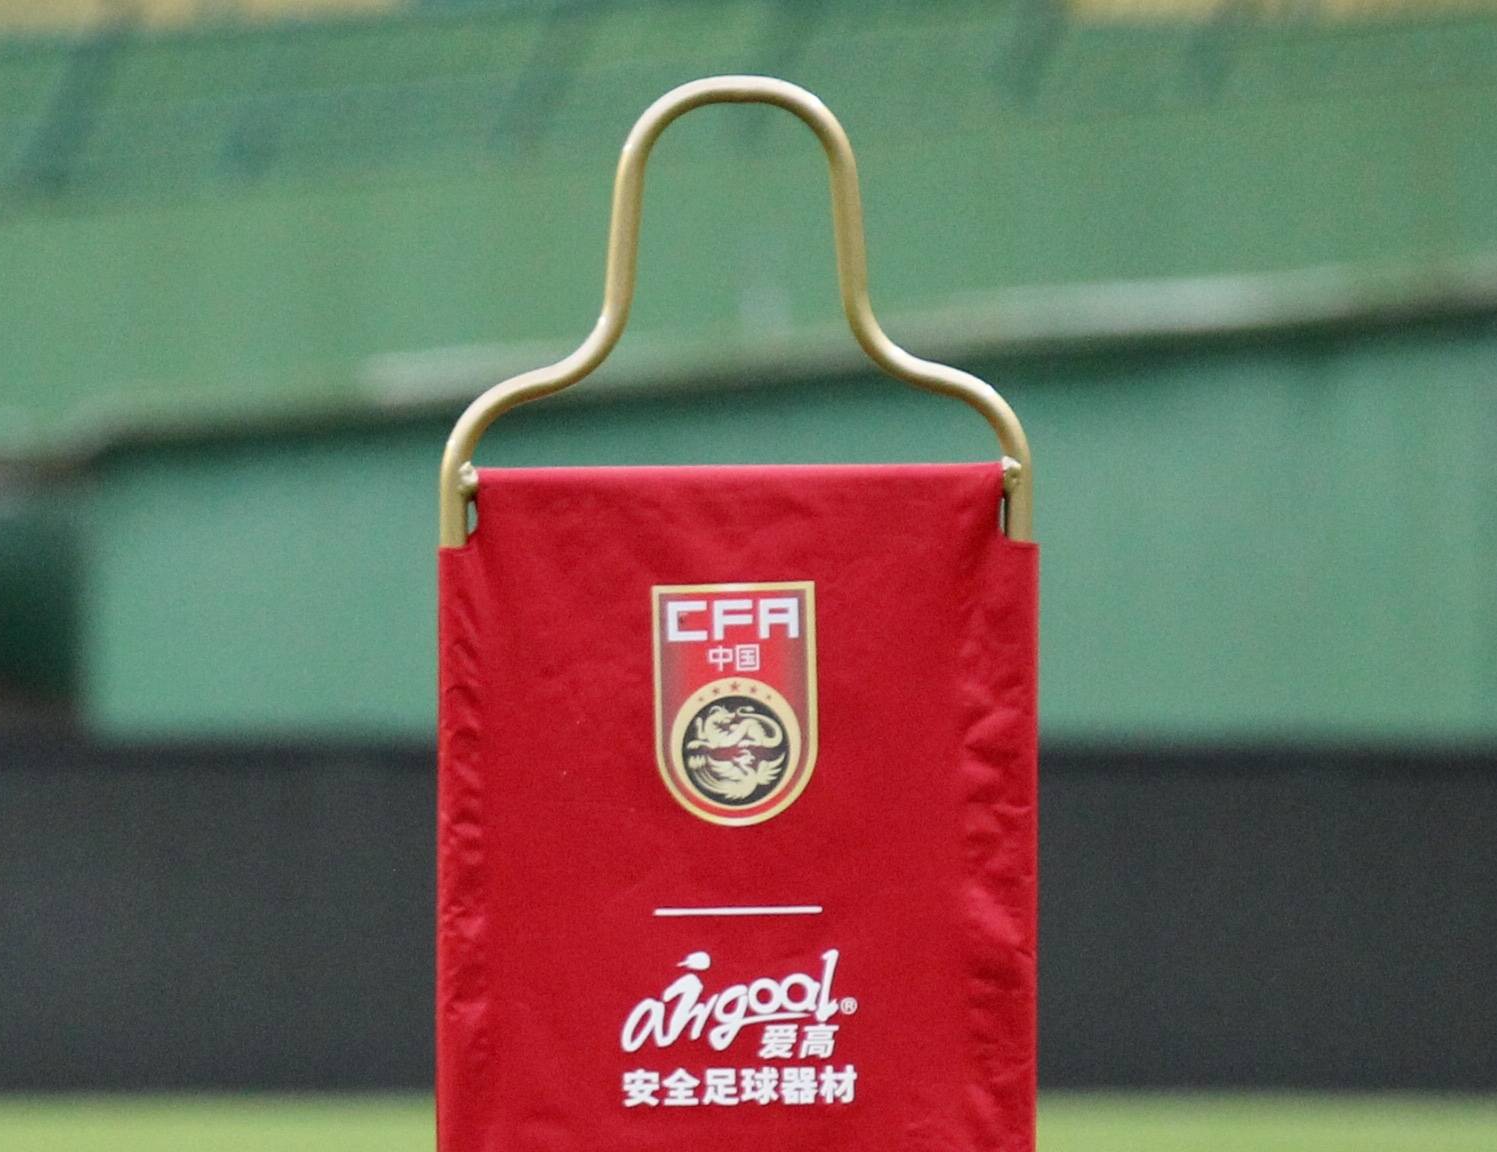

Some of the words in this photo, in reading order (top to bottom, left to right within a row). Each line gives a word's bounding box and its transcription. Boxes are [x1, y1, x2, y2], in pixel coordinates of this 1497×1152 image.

[666, 597, 800, 642] CFA
[708, 643, 760, 672] 中国
[758, 1023, 840, 1059] 爱高
[622, 1064, 858, 1108] 安全足球器材
